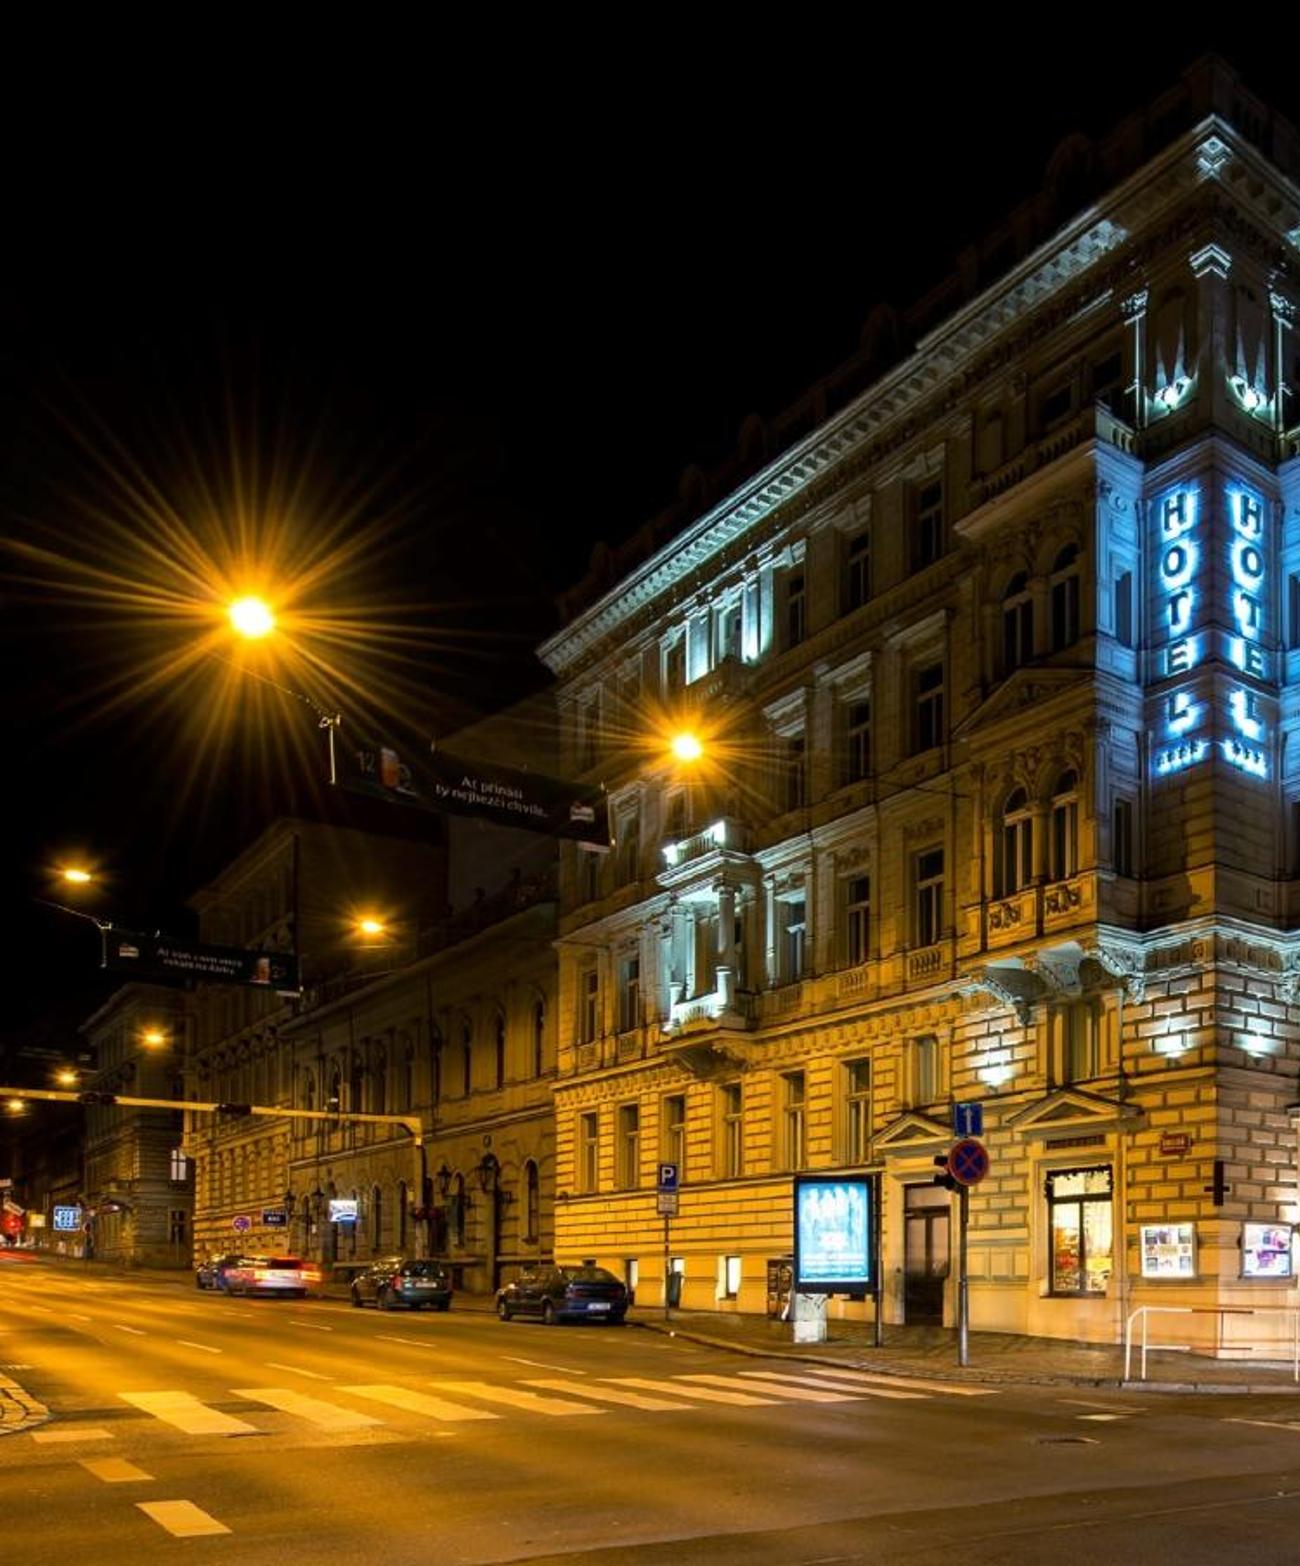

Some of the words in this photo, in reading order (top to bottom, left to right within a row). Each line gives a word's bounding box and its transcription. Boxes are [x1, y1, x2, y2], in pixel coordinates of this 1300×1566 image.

[1162, 491, 1190, 722] HOTEL
[1239, 492, 1265, 728] HOTEL
[661, 1167, 675, 1184] P
